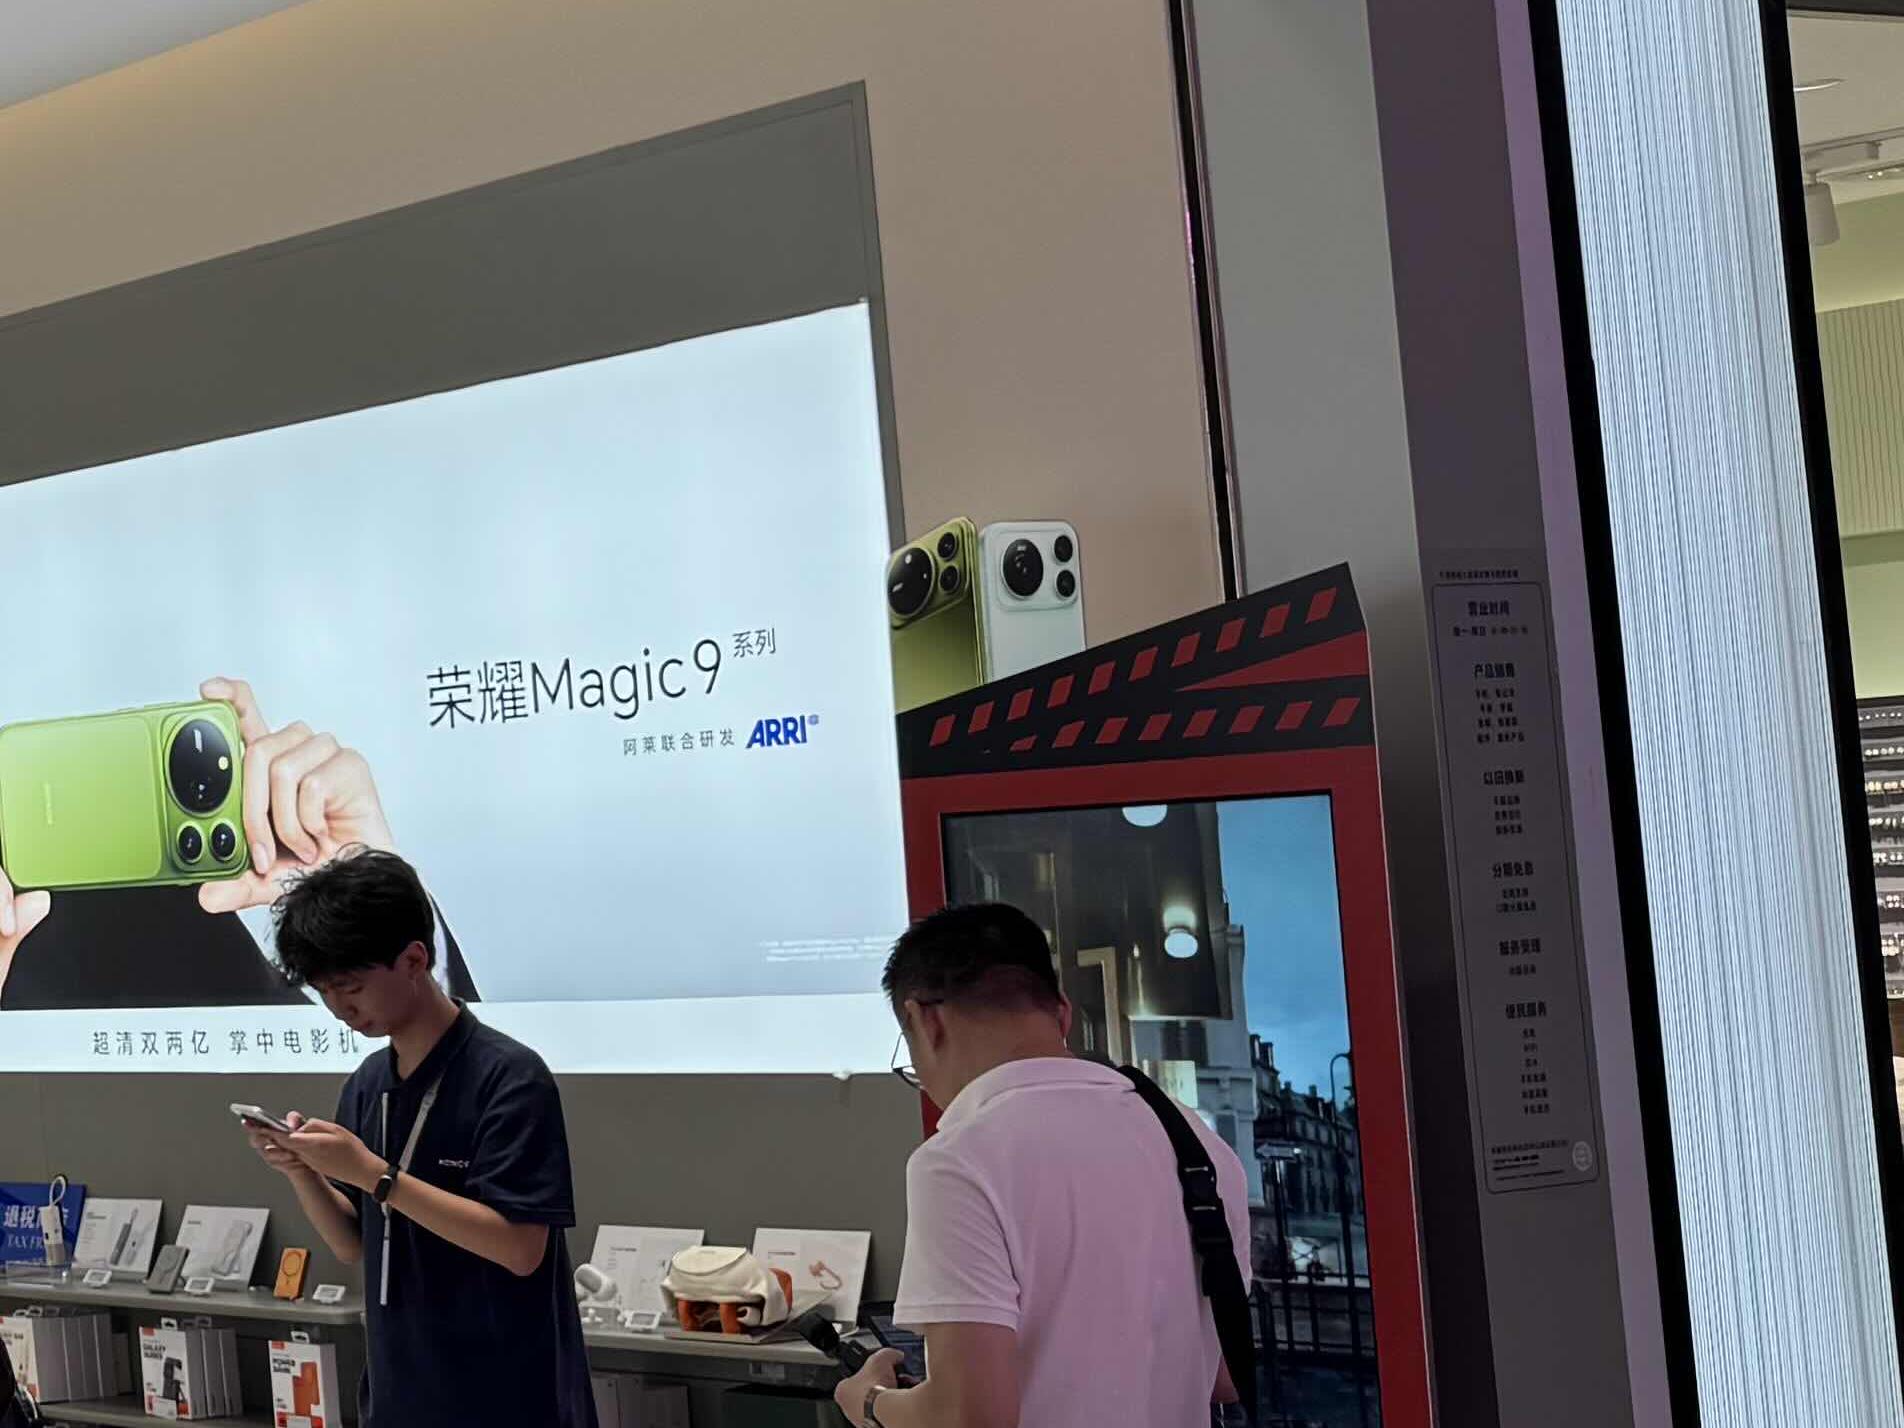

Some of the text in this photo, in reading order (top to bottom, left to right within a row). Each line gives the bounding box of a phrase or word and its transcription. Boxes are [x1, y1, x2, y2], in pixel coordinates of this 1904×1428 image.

[623, 729, 735, 756] 阿莱联合研发
[92, 1028, 360, 1056] 超清双两亿 掌中电影机
[3, 1204, 69, 1229] 退税
